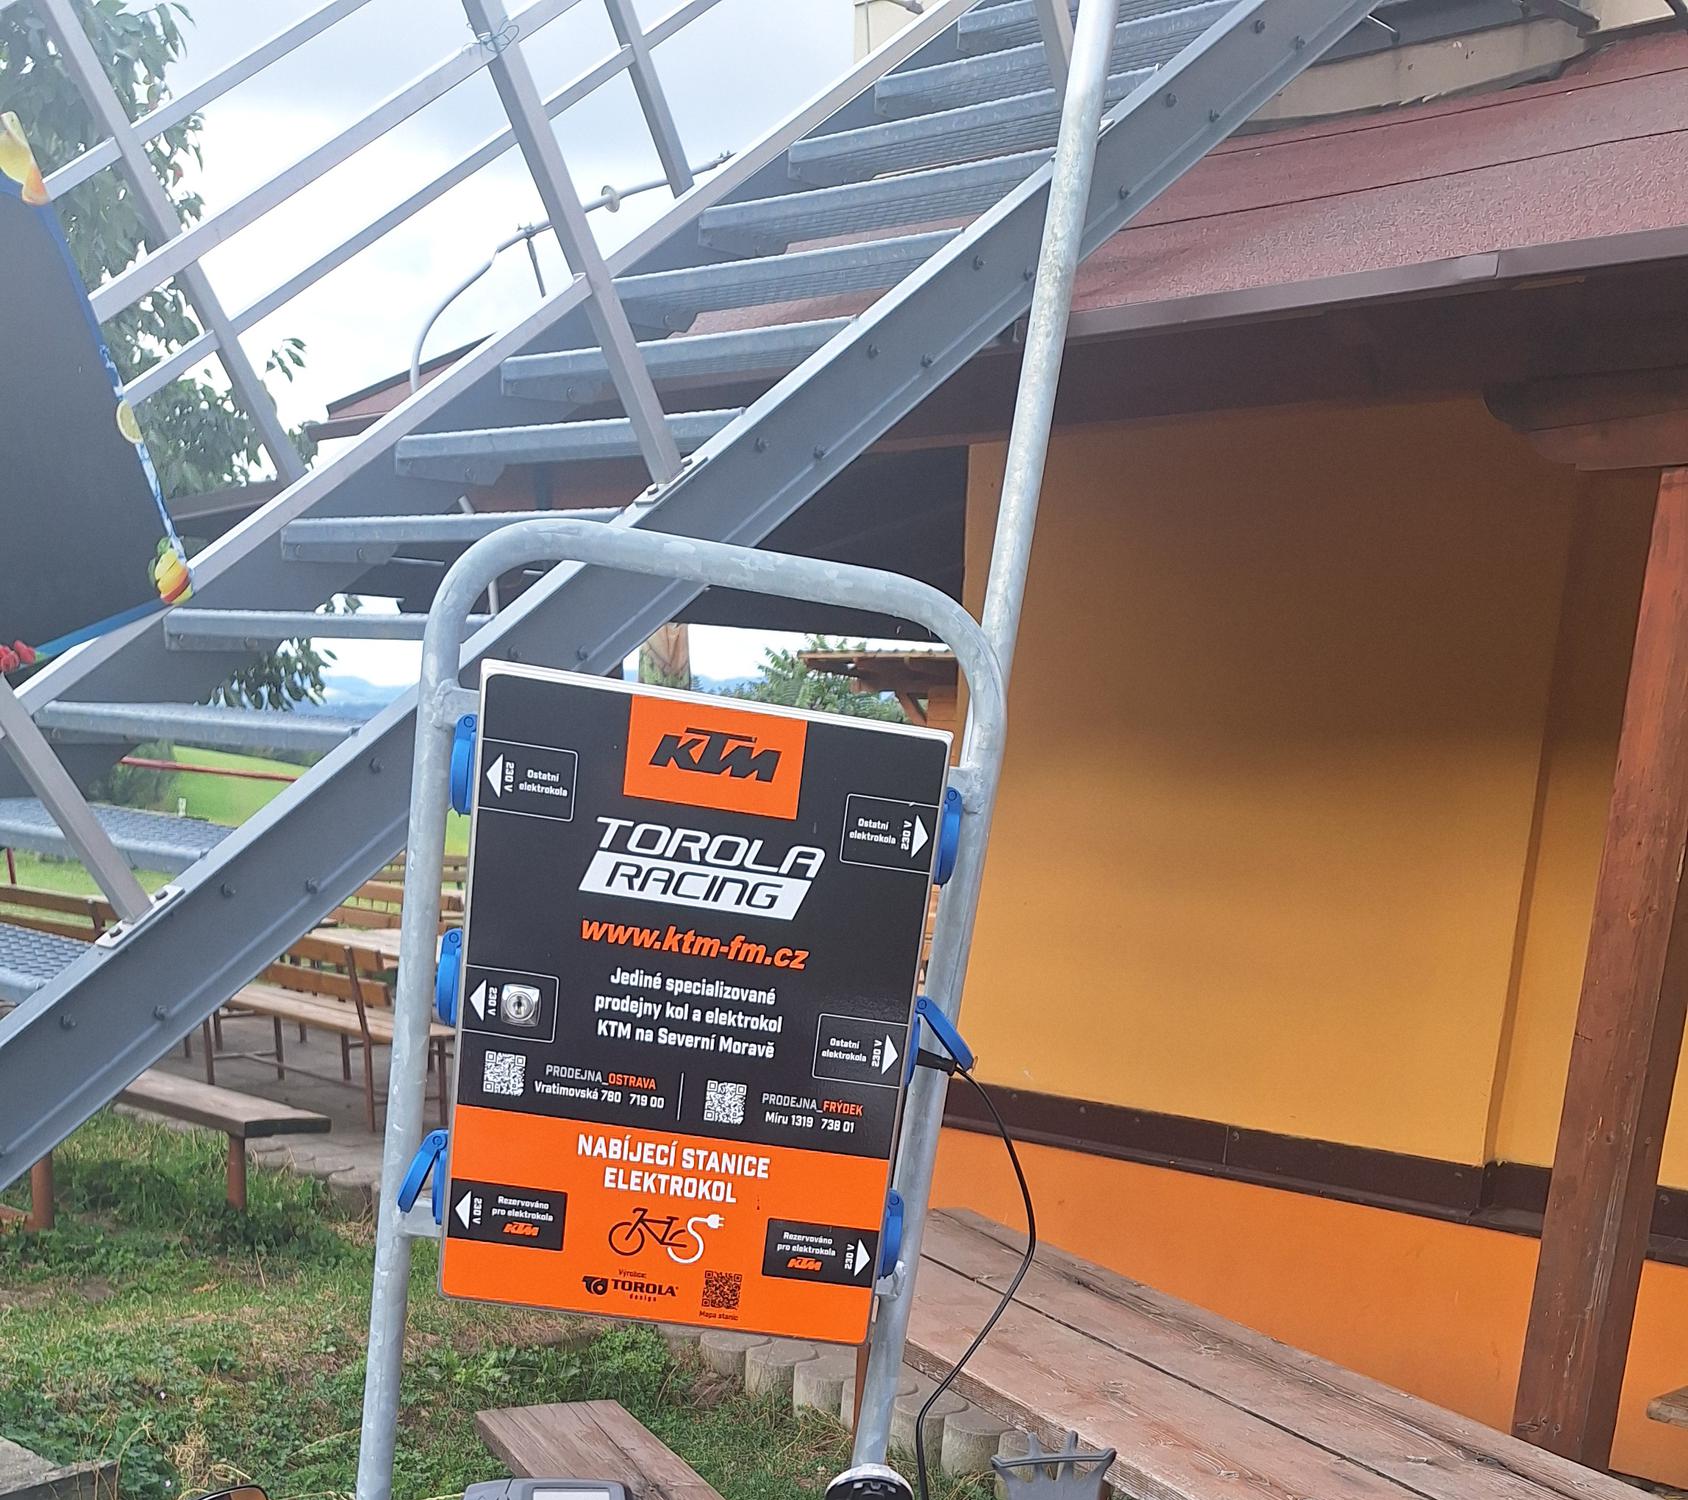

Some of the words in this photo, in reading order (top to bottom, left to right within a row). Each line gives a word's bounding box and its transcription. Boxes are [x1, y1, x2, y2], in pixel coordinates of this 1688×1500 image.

[649, 727, 782, 783] KTM
[505, 762, 514, 783] 230
[527, 769, 559, 782] Ostatní
[504, 784, 513, 792] V
[519, 782, 568, 797] elektrokola
[858, 818, 889, 831] Ostatní
[849, 830, 896, 845] elektrokola
[901, 830, 911, 850] 230
[597, 816, 826, 878] TOROLA
[605, 861, 783, 910] RACING
[581, 919, 809, 969] www.ktm-fm.cz
[610, 967, 662, 990] Jediné
[665, 978, 776, 1006] specializované
[488, 987, 498, 1007] 230
[594, 994, 662, 1020] prodejny
[665, 1001, 689, 1021] kol
[692, 1009, 702, 1022] a
[705, 1008, 783, 1033] elektrokol
[597, 1019, 632, 1040] KTM
[635, 1028, 654, 1043] na
[657, 1027, 717, 1051] Severní
[719, 1036, 775, 1059] Moravě
[830, 1038, 860, 1050] Ostatní
[822, 1049, 867, 1062] elektrokola
[871, 1049, 881, 1067] 230
[545, 1064, 657, 1090] PRODEJNA_OSTRAVA
[534, 1080, 599, 1101] Vratimovská
[600, 1090, 622, 1103] 780
[629, 1094, 648, 1106] 719
[650, 1096, 665, 1109] 00
[762, 1093, 863, 1116] PRODEJNA_FRÝDEK
[765, 1111, 788, 1125] Míru
[791, 1115, 814, 1128] 1319
[821, 1118, 841, 1132] 738
[843, 1121, 855, 1133] 01
[578, 1133, 679, 1168] NABÍJECÍ
[682, 1148, 771, 1179] STANICE
[603, 1166, 737, 1204] ELEKTROKOL
[473, 1198, 482, 1216] 230
[498, 1196, 549, 1210] Rezervováno
[492, 1208, 506, 1216] pro
[507, 1209, 554, 1222] elektrokola
[503, 1222, 539, 1236] KTM
[783, 1231, 833, 1245] Rezervováno
[777, 1243, 790, 1251] pro
[792, 1244, 836, 1256] elektrokola
[787, 1257, 822, 1271] KTM
[845, 1253, 854, 1270] 230
[630, 1294, 657, 1302] design
[699, 1310, 717, 1320] Mapa
[718, 1312, 739, 1320] stanic
